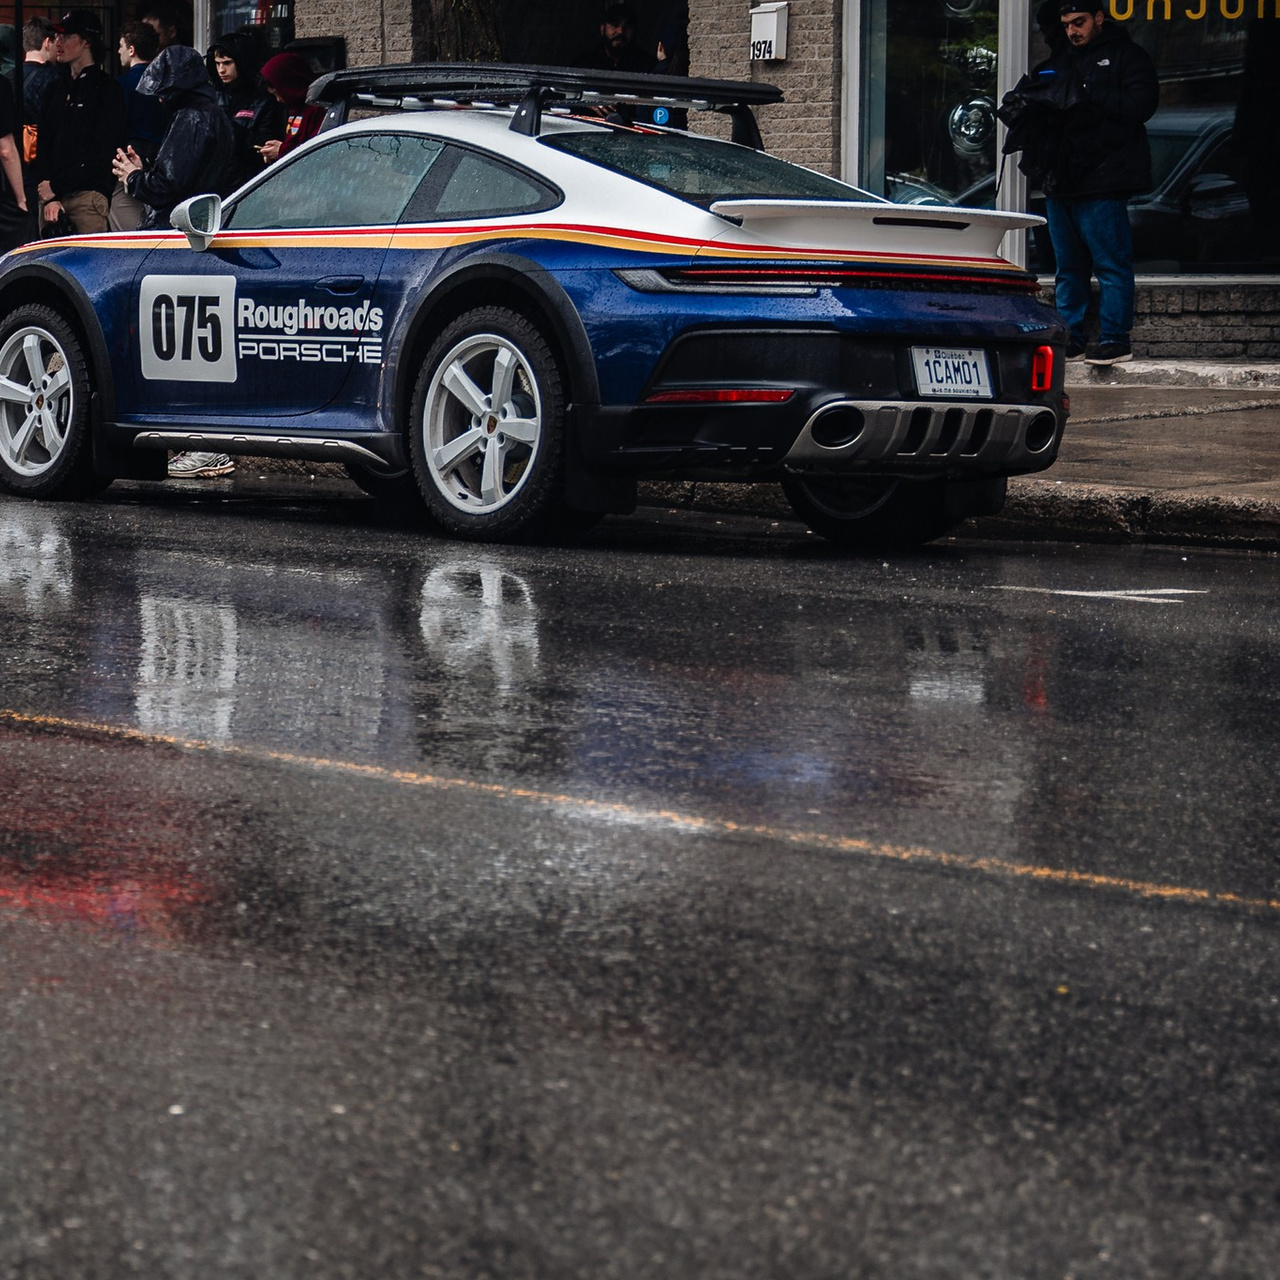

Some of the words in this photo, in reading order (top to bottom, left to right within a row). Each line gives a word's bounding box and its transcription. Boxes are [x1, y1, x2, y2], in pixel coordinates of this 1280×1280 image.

[751, 40, 773, 60] 1974
[152, 294, 222, 362] 075
[238, 298, 383, 335] Roughroads
[238, 342, 382, 364] PORSCHE
